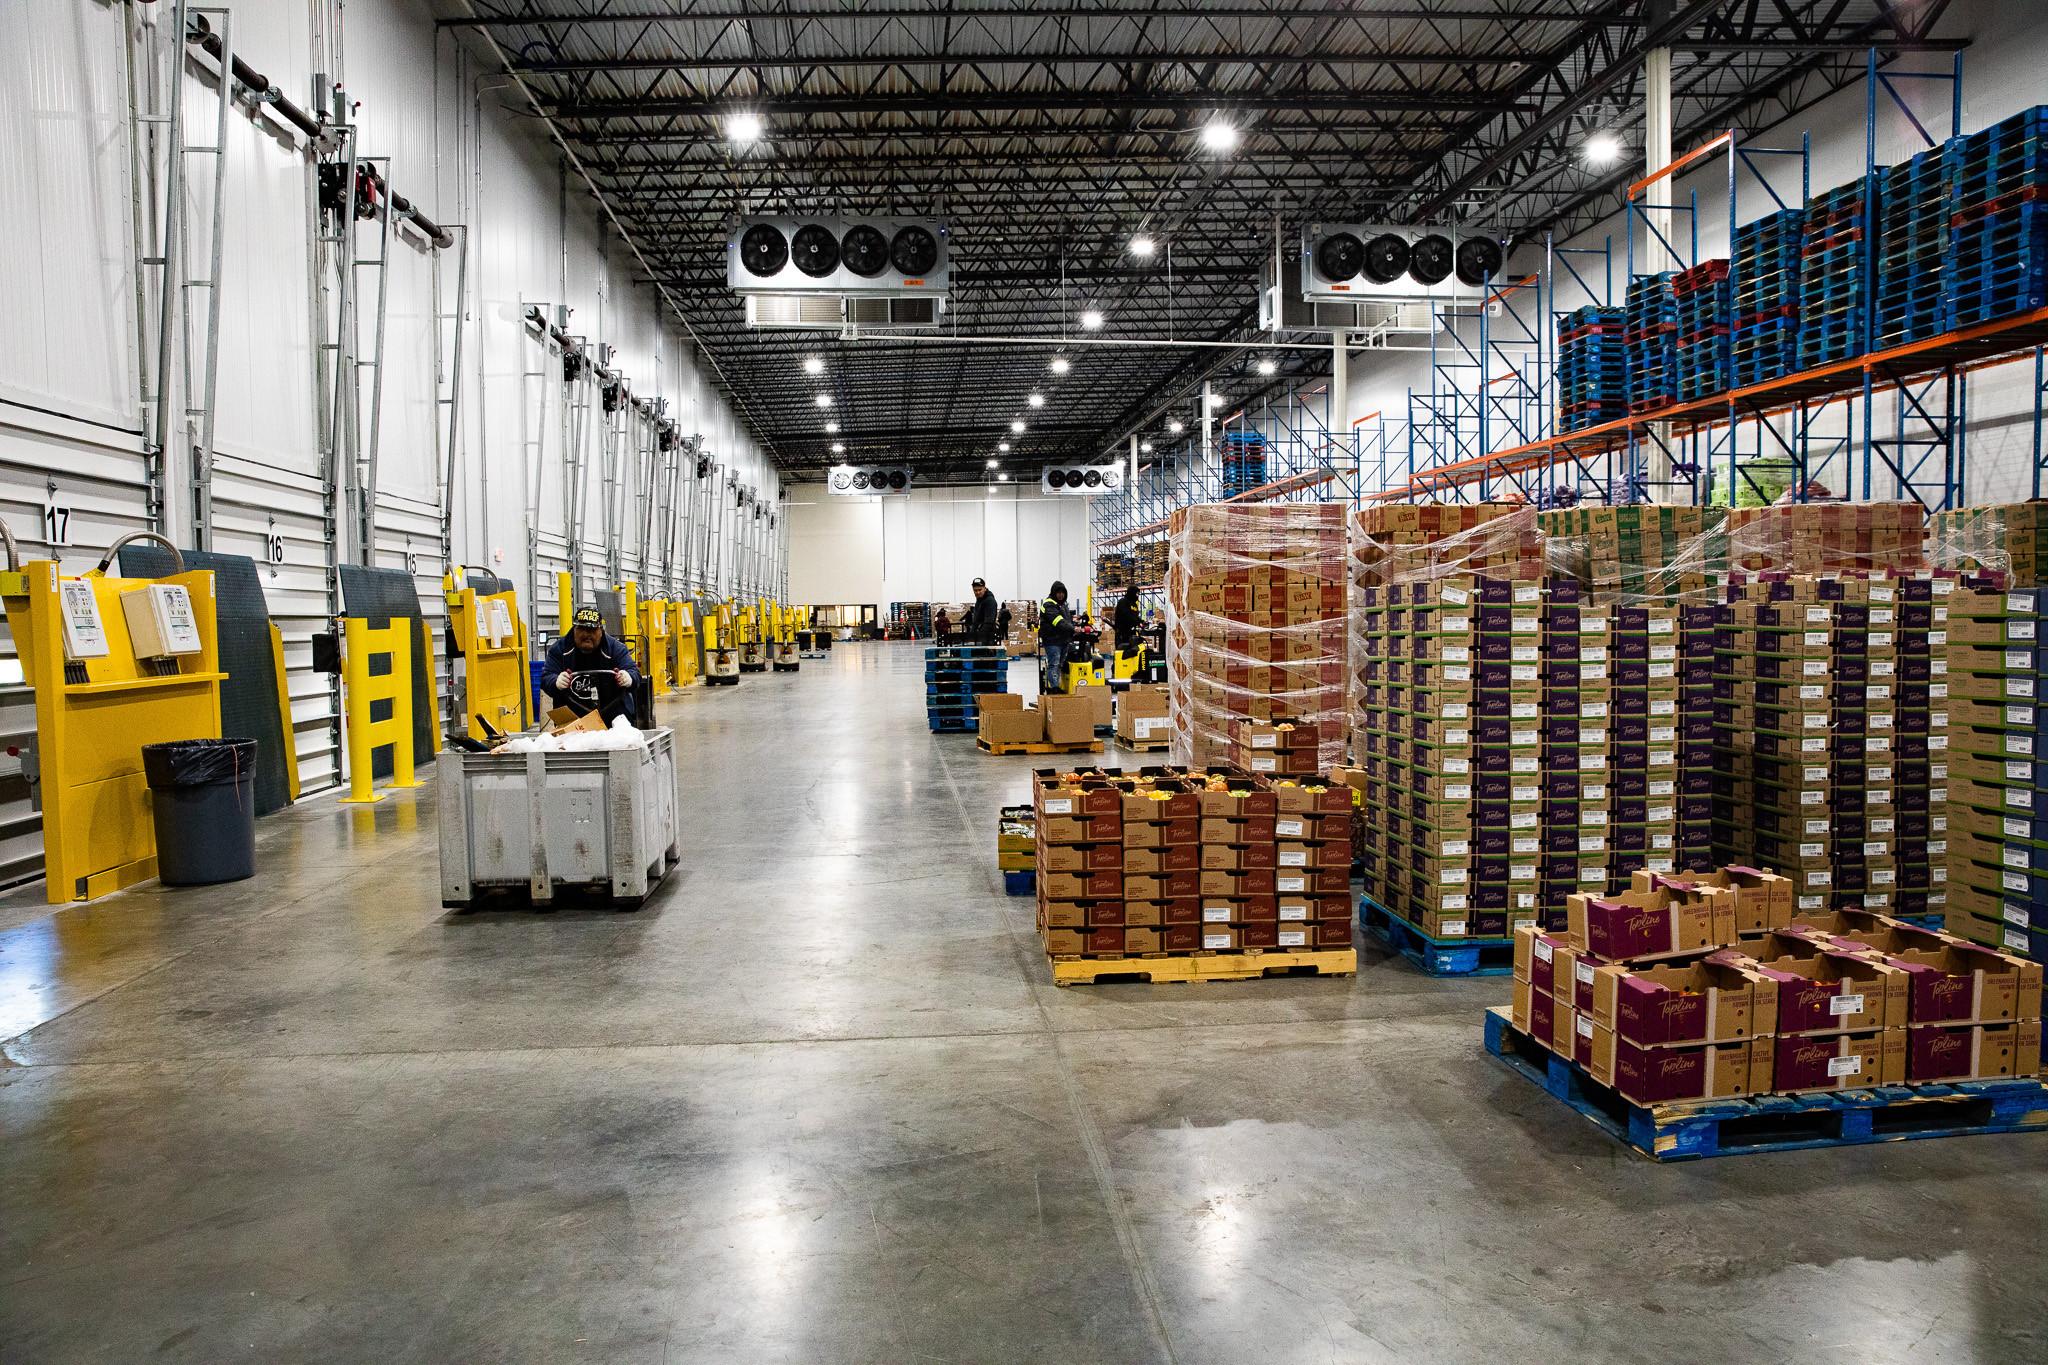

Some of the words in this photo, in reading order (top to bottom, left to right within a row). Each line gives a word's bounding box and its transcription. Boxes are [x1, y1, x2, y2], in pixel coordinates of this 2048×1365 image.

[46, 506, 70, 543] 17
[269, 534, 283, 562] 16
[407, 552, 417, 575] 15
[1624, 913, 1661, 936] Topline
[1795, 987, 1831, 1010] Topline
[1929, 979, 1963, 1000] Topline
[1657, 998, 1697, 1020] Topline
[1793, 1046, 1831, 1068] Topline
[1928, 1036, 1961, 1057] Topline
[1657, 1055, 1696, 1077] Topline
